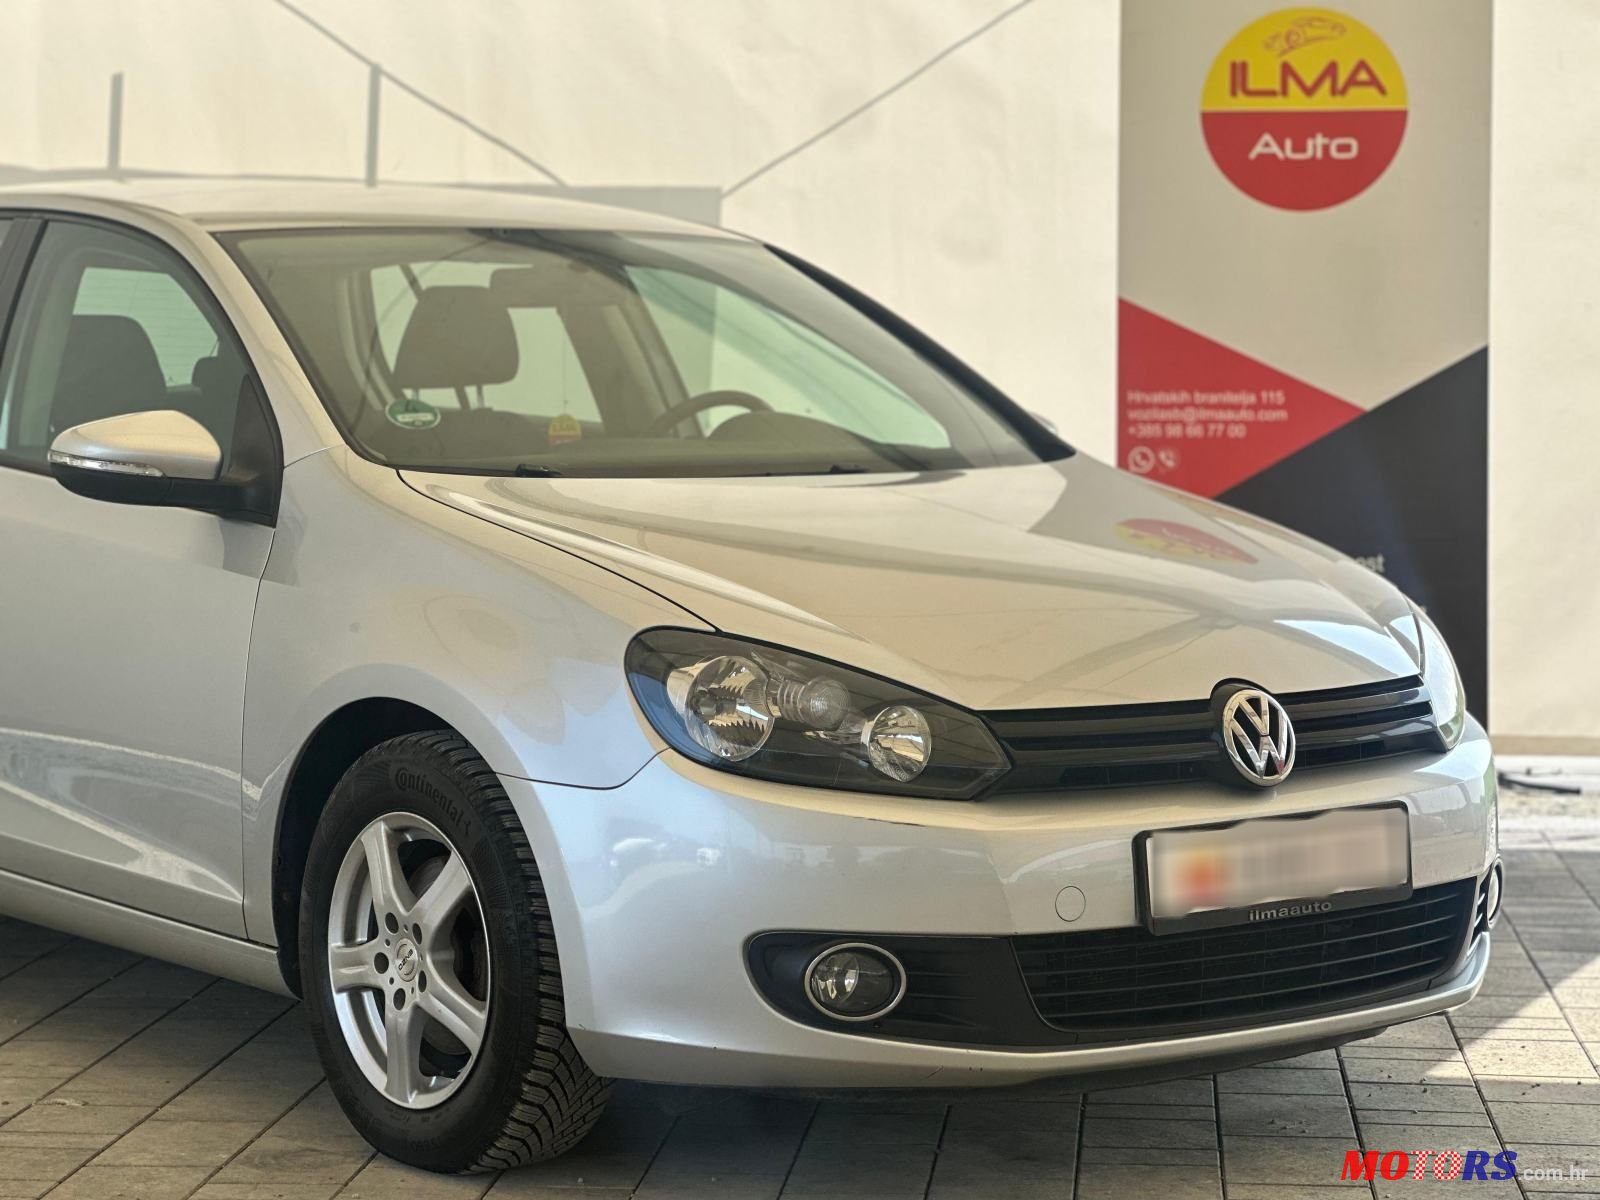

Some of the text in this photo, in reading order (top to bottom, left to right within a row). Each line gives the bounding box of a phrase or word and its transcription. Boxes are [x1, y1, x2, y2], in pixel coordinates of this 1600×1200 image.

[1229, 59, 1388, 98] ILMA
[1248, 132, 1360, 161] Auto
[394, 767, 464, 827] Continental
[1249, 900, 1333, 922] ilmaauto
